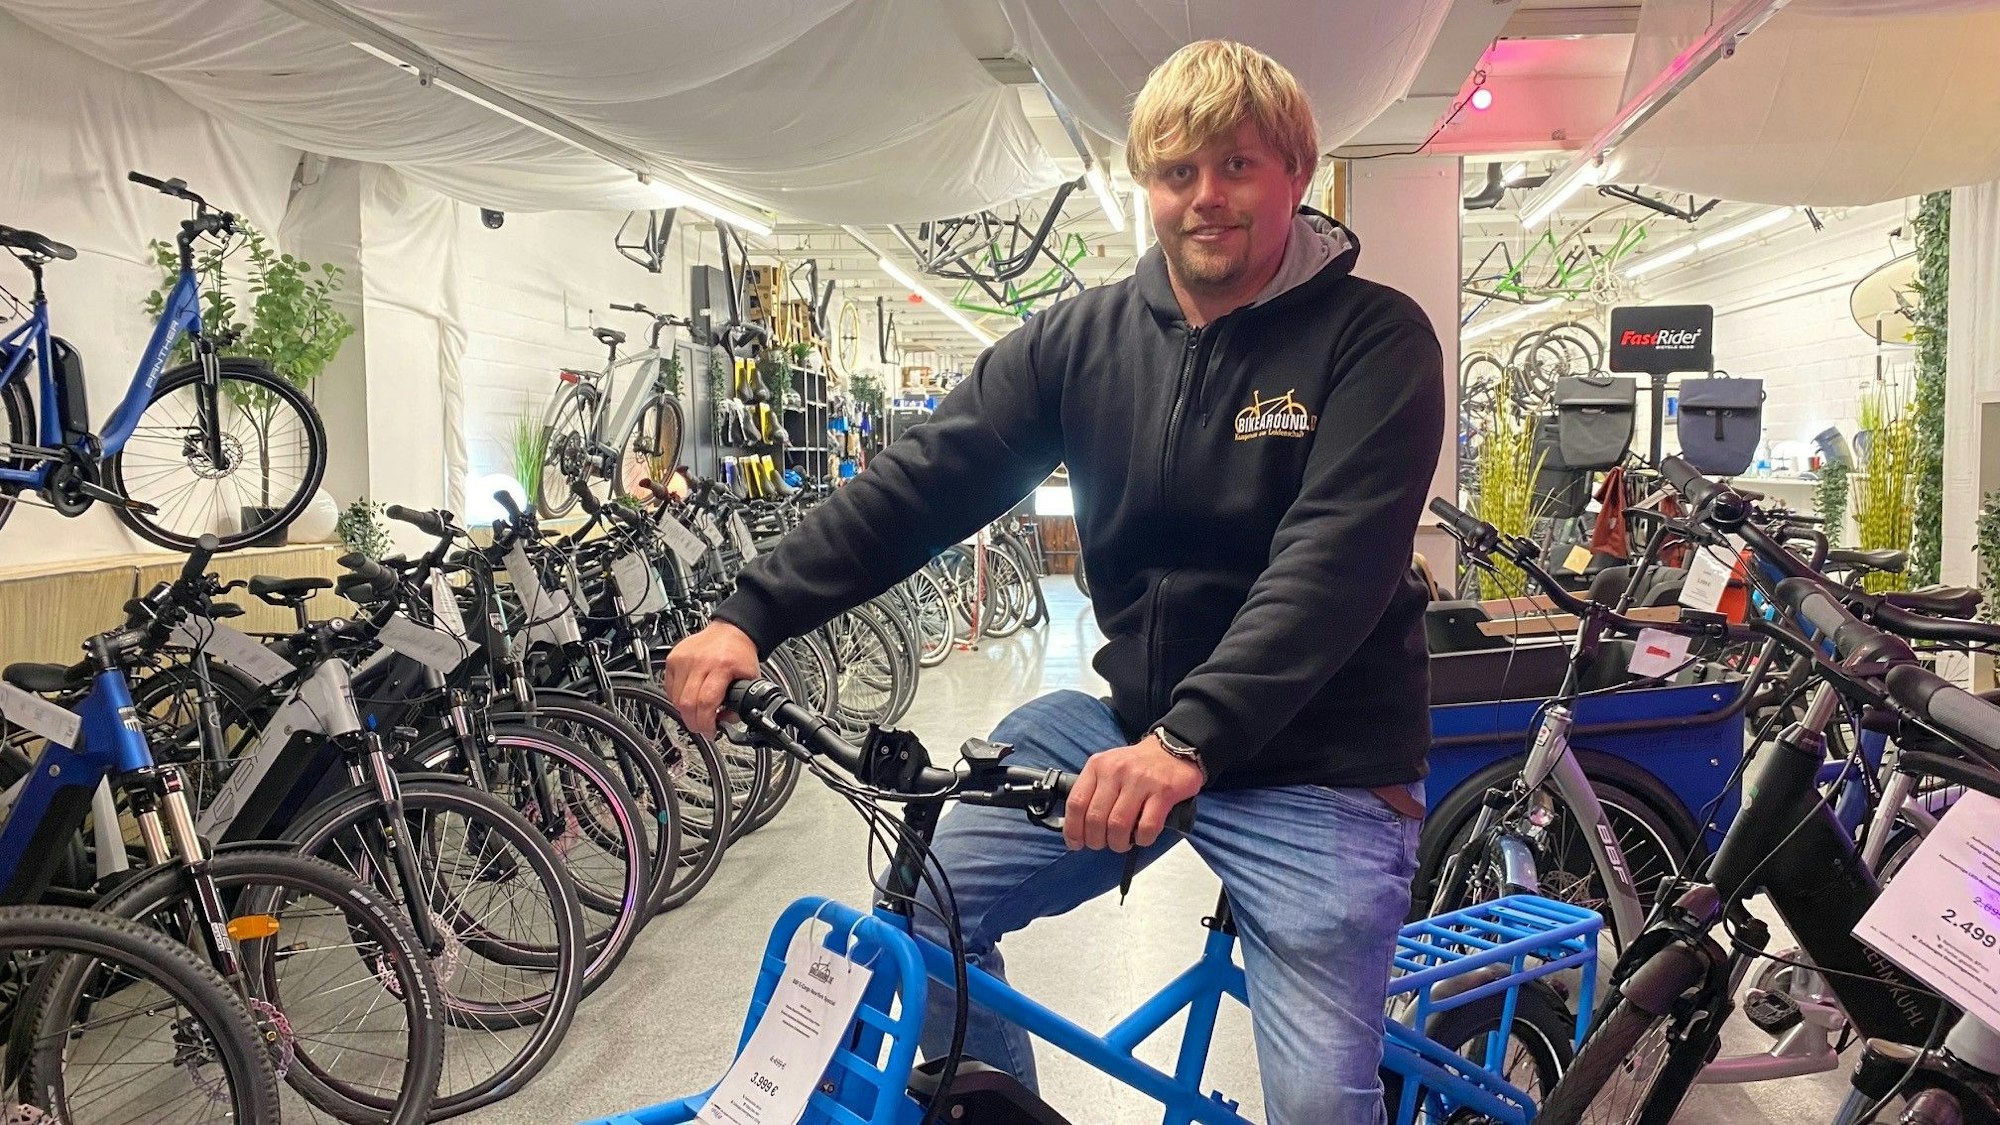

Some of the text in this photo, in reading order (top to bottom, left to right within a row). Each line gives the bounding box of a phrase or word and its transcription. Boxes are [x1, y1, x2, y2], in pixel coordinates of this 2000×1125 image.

[145, 319, 179, 389] PANTHER
[1620, 328, 1702, 346] FastRider
[1596, 824, 1629, 885] BBF
[1940, 908, 1997, 948] 2.499
[369, 904, 434, 1020] HURRICANE
[750, 1071, 779, 1097] 3.999 €
